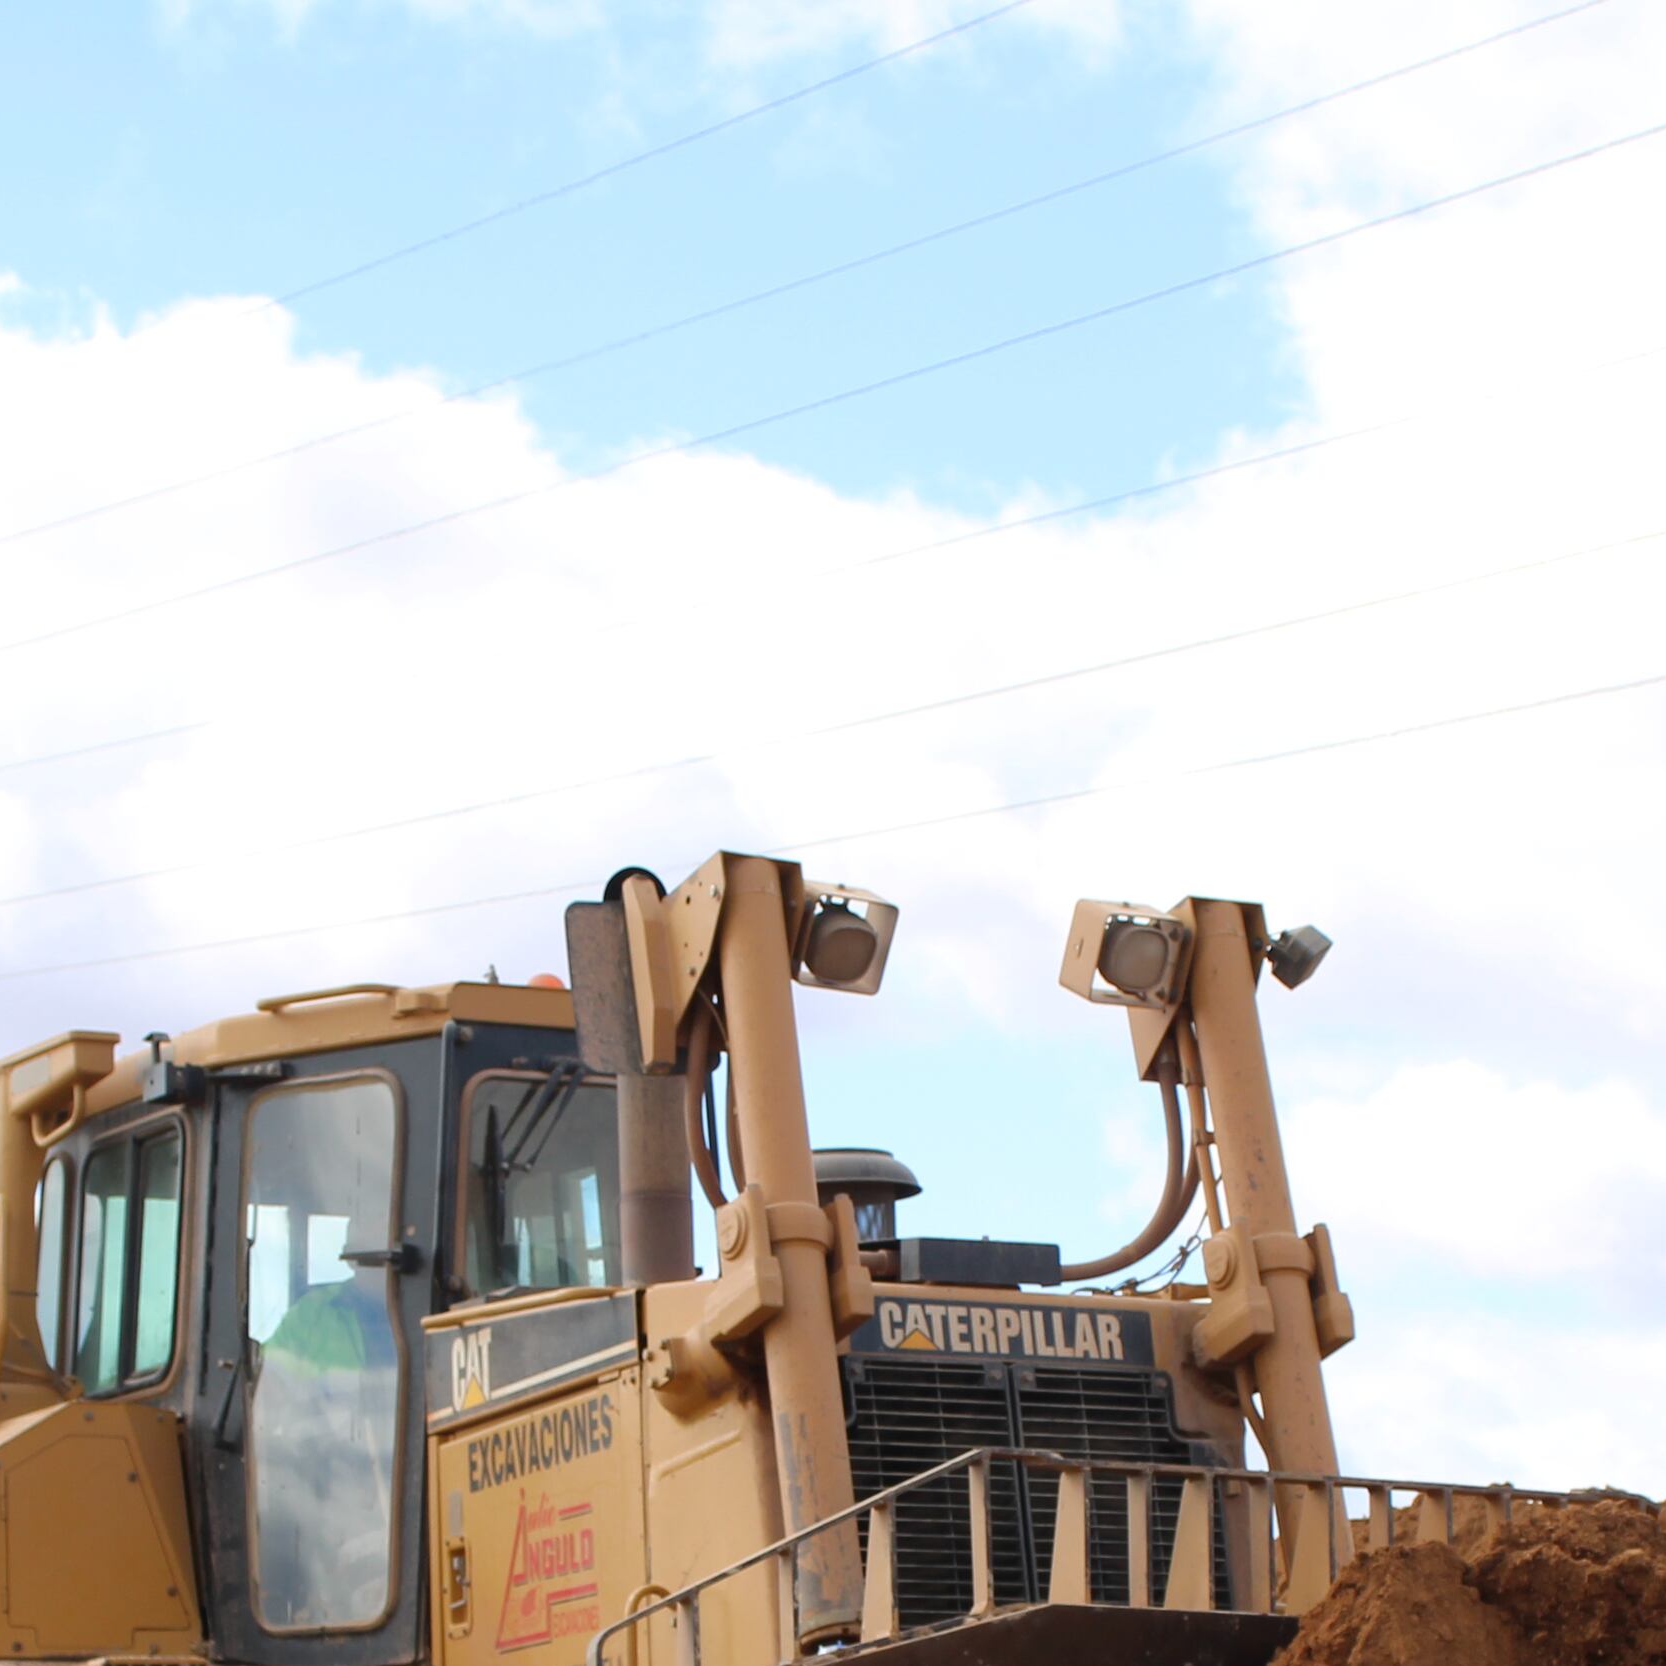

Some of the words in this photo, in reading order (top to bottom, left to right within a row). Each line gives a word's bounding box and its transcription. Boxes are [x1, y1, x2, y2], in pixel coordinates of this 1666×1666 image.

[451, 1327, 492, 1412] CAT
[879, 1301, 1124, 1360] CATERPILLAR
[468, 1394, 613, 1493] EXCAVACIONES
